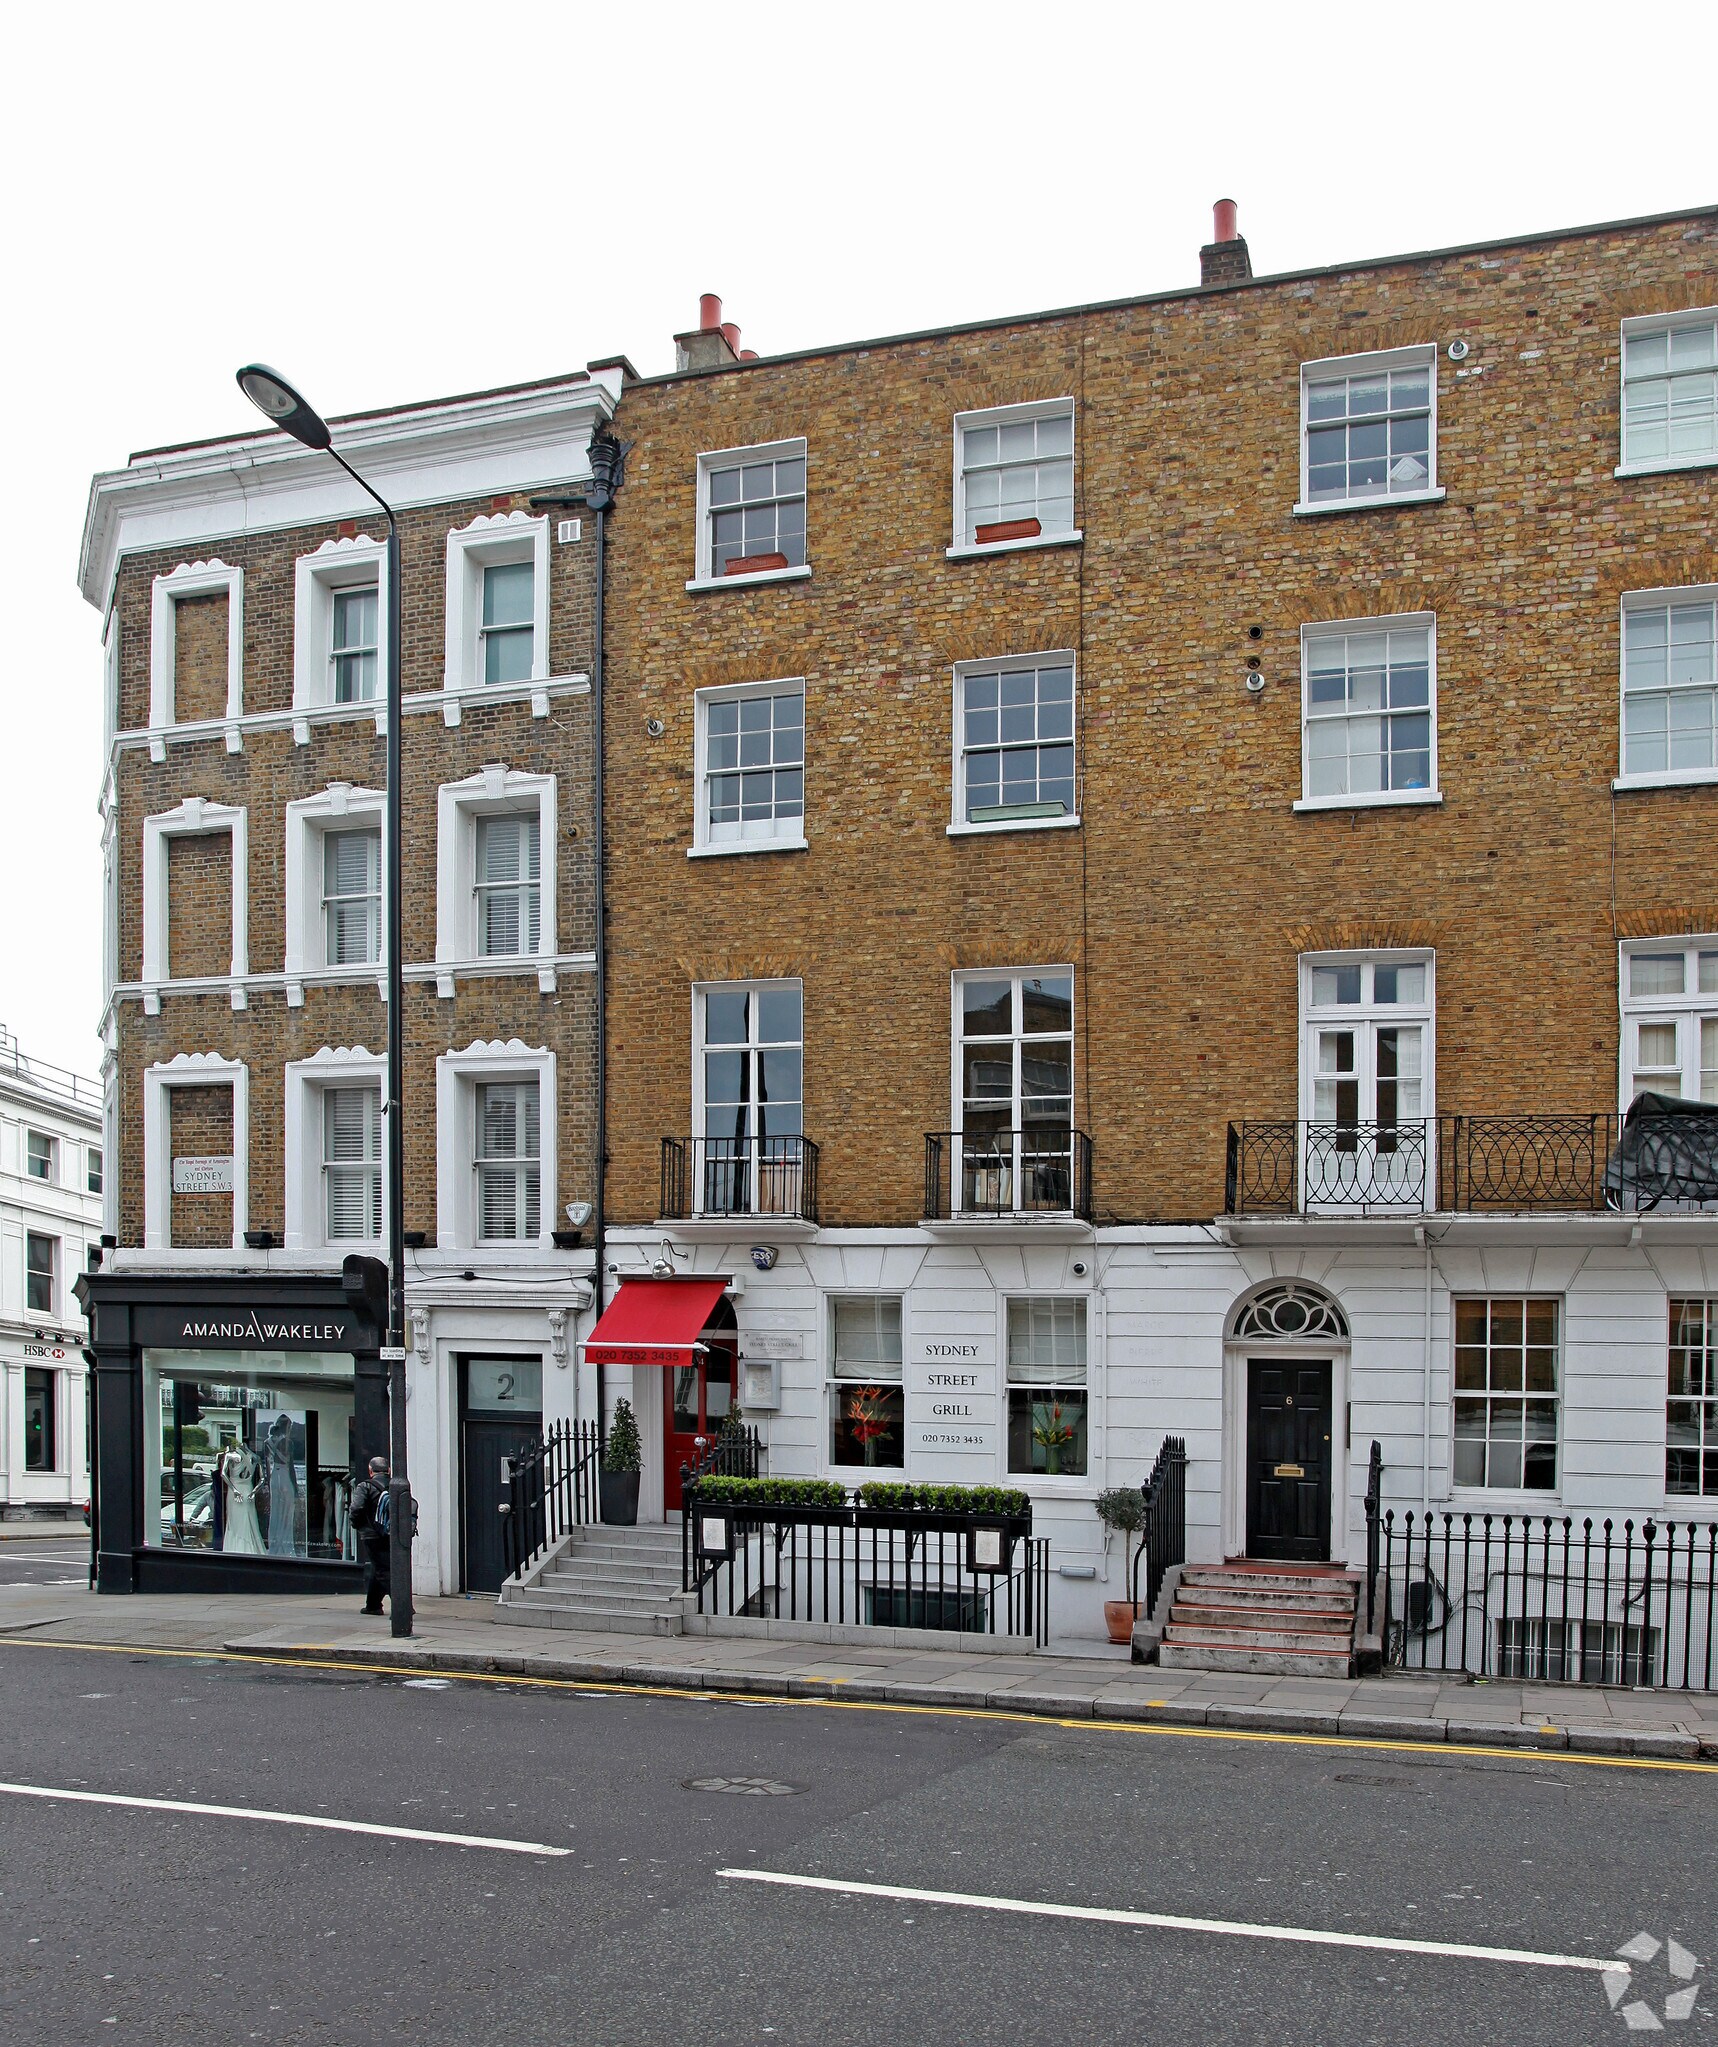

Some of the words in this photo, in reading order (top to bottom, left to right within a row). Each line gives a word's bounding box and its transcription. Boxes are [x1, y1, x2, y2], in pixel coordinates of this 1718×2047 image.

[184, 1172, 223, 1180] SYDNEY
[24, 1345, 51, 1357] HSBC
[595, 1350, 617, 1360] 020
[621, 1351, 647, 1360] 7352
[651, 1352, 679, 1361] 3435
[925, 1345, 979, 1356] SYDNEY
[928, 1374, 978, 1386] STREET
[498, 1373, 514, 1400] 2
[1286, 1396, 1293, 1405] 6
[932, 1404, 972, 1416] GRILL
[922, 1434, 938, 1443] 020
[940, 1435, 960, 1444] 7352
[963, 1436, 983, 1444] 3435
